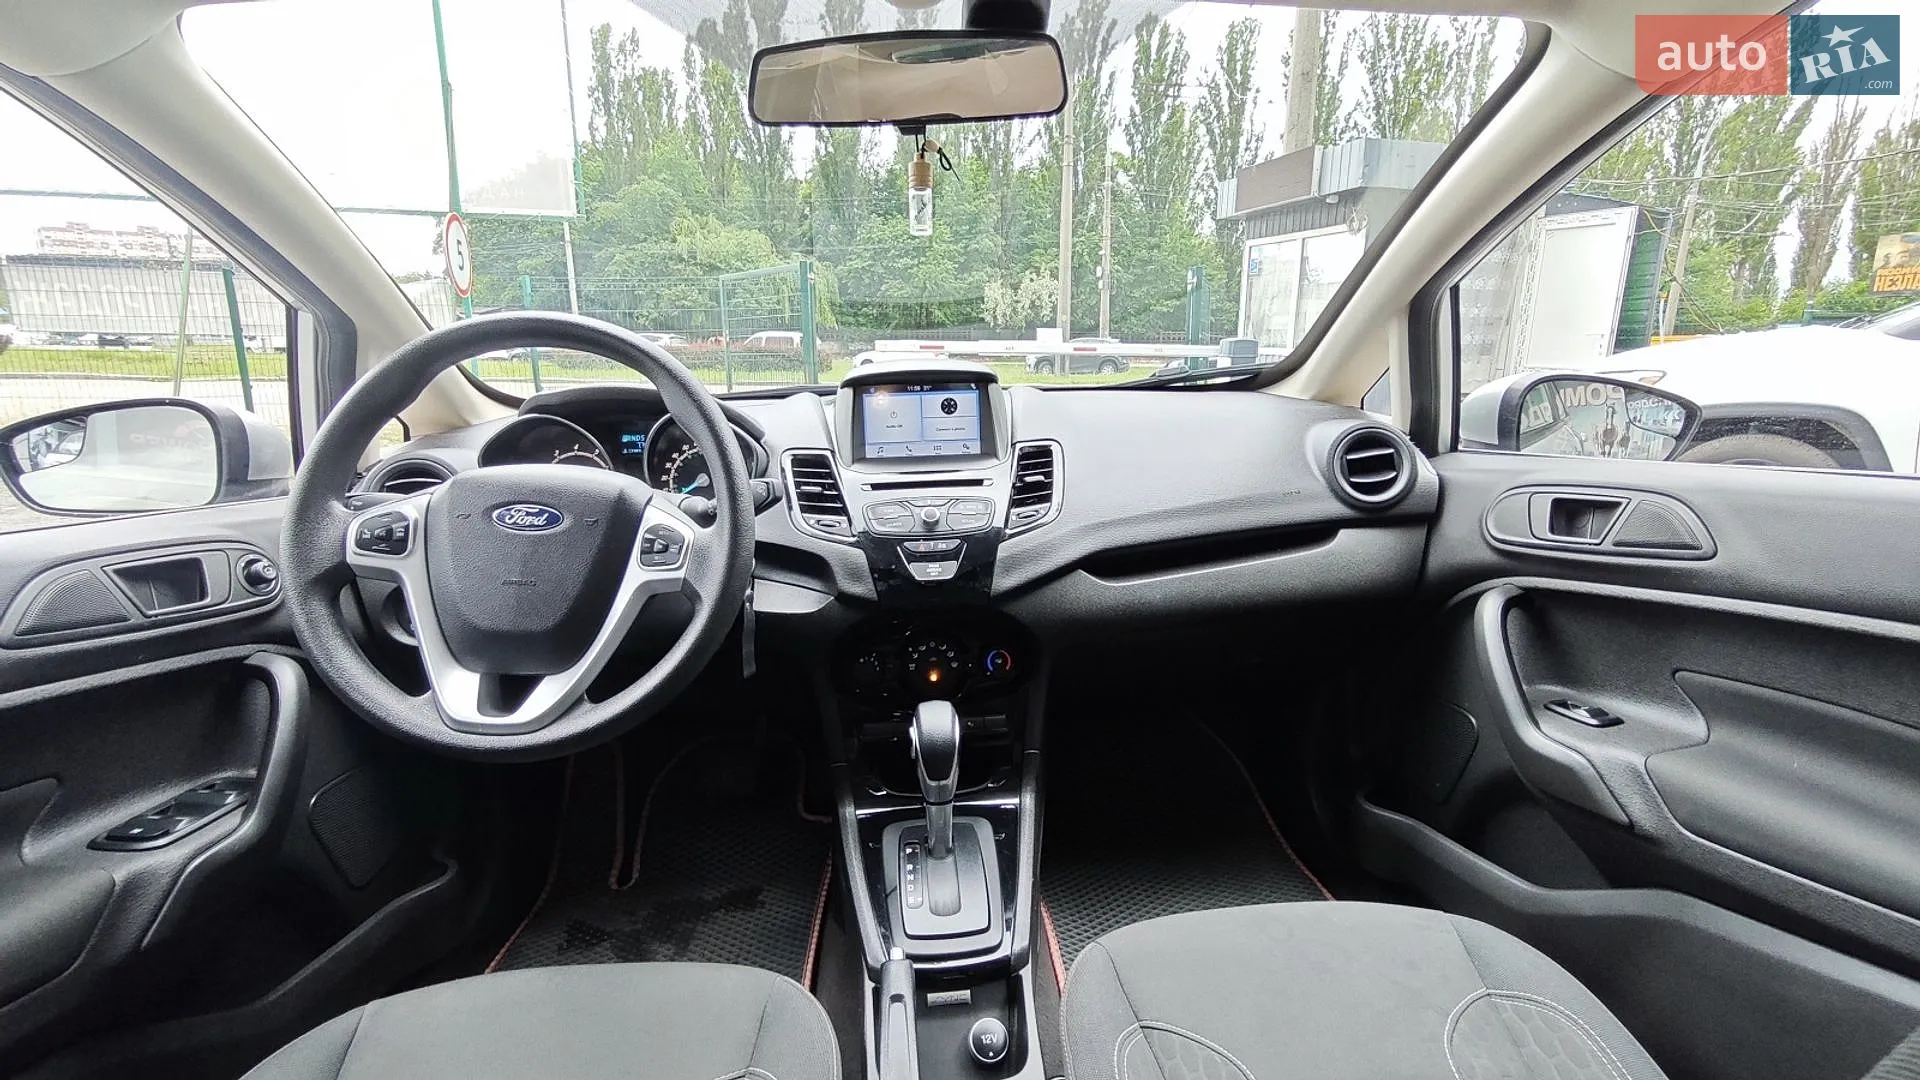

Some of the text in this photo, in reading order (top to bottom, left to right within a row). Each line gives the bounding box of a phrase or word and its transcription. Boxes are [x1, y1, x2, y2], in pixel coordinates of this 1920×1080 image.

[456, 239, 465, 272] 5
[504, 505, 548, 527] Ford
[907, 884, 914, 892] D
[980, 1033, 998, 1045] 12V
